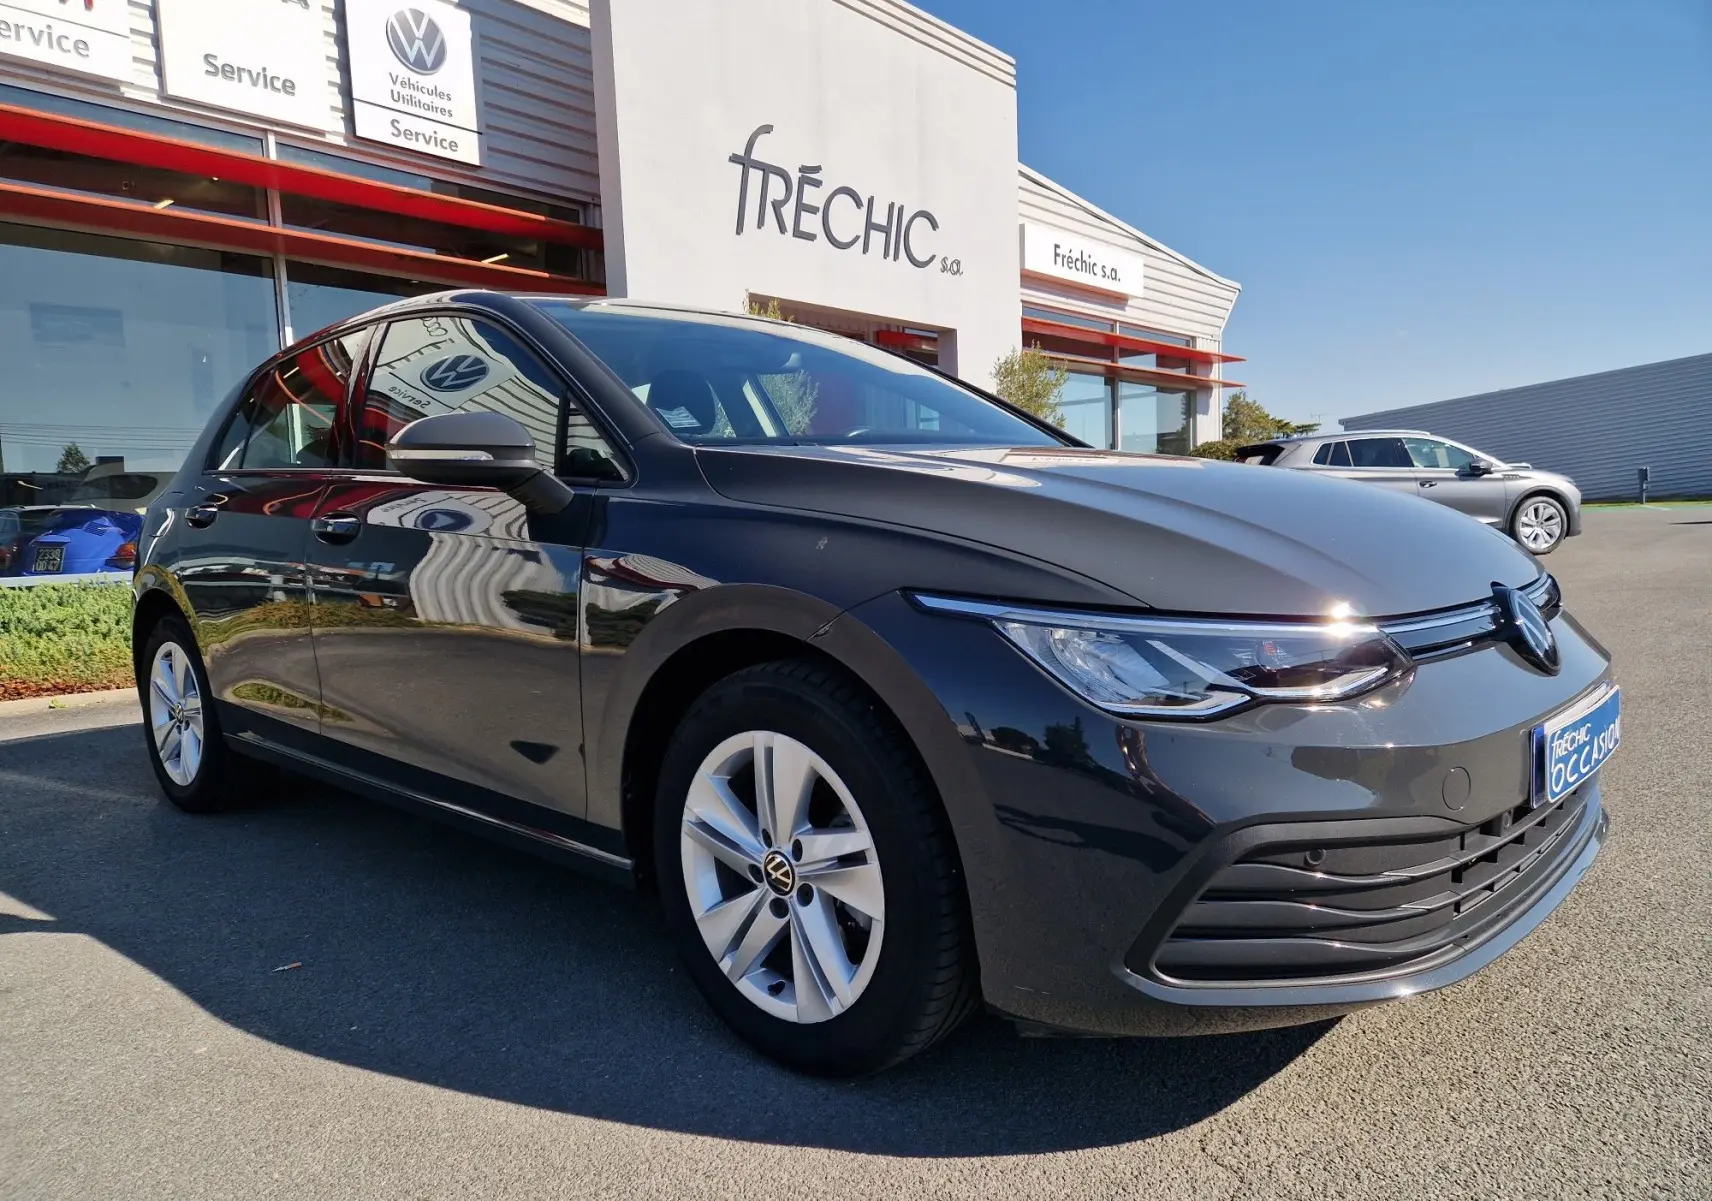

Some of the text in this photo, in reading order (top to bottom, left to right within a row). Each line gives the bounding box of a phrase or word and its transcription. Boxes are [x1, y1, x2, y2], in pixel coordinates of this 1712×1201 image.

[0, 20, 90, 58] ervice
[203, 53, 296, 97] Service
[389, 72, 452, 101] Véhicules
[390, 89, 453, 118] Utilitaires
[390, 118, 459, 152] Service
[1054, 243, 1121, 282] Fréchic s.a.
